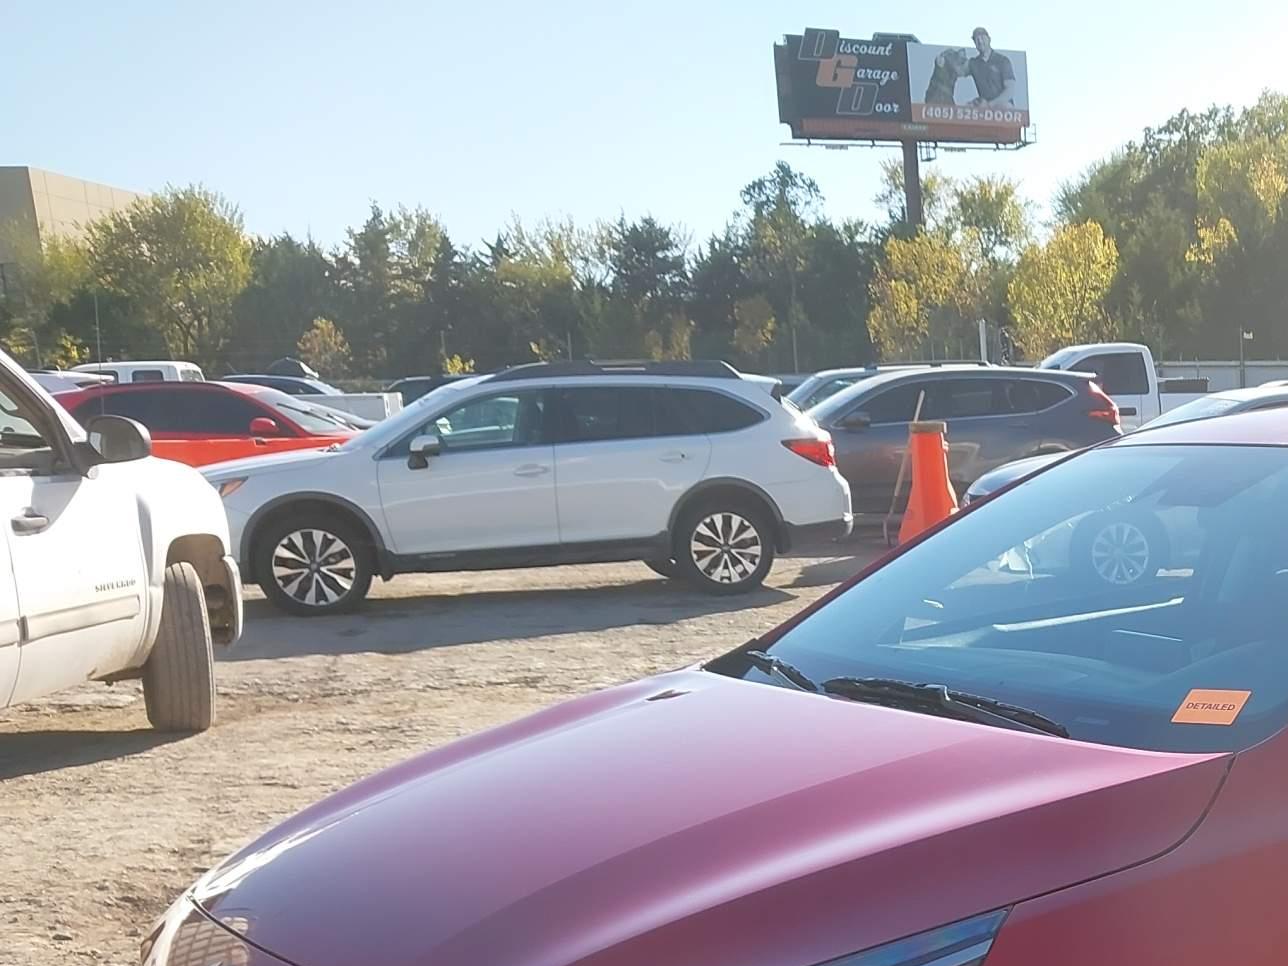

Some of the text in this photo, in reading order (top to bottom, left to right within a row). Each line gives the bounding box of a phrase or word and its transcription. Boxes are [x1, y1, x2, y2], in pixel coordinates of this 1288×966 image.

[798, 28, 893, 60] Discount
[816, 54, 898, 88] Garage
[836, 82, 899, 116] Door
[921, 105, 1022, 123] (405) 525-DOOR
[1186, 702, 1236, 710] DETAILED
